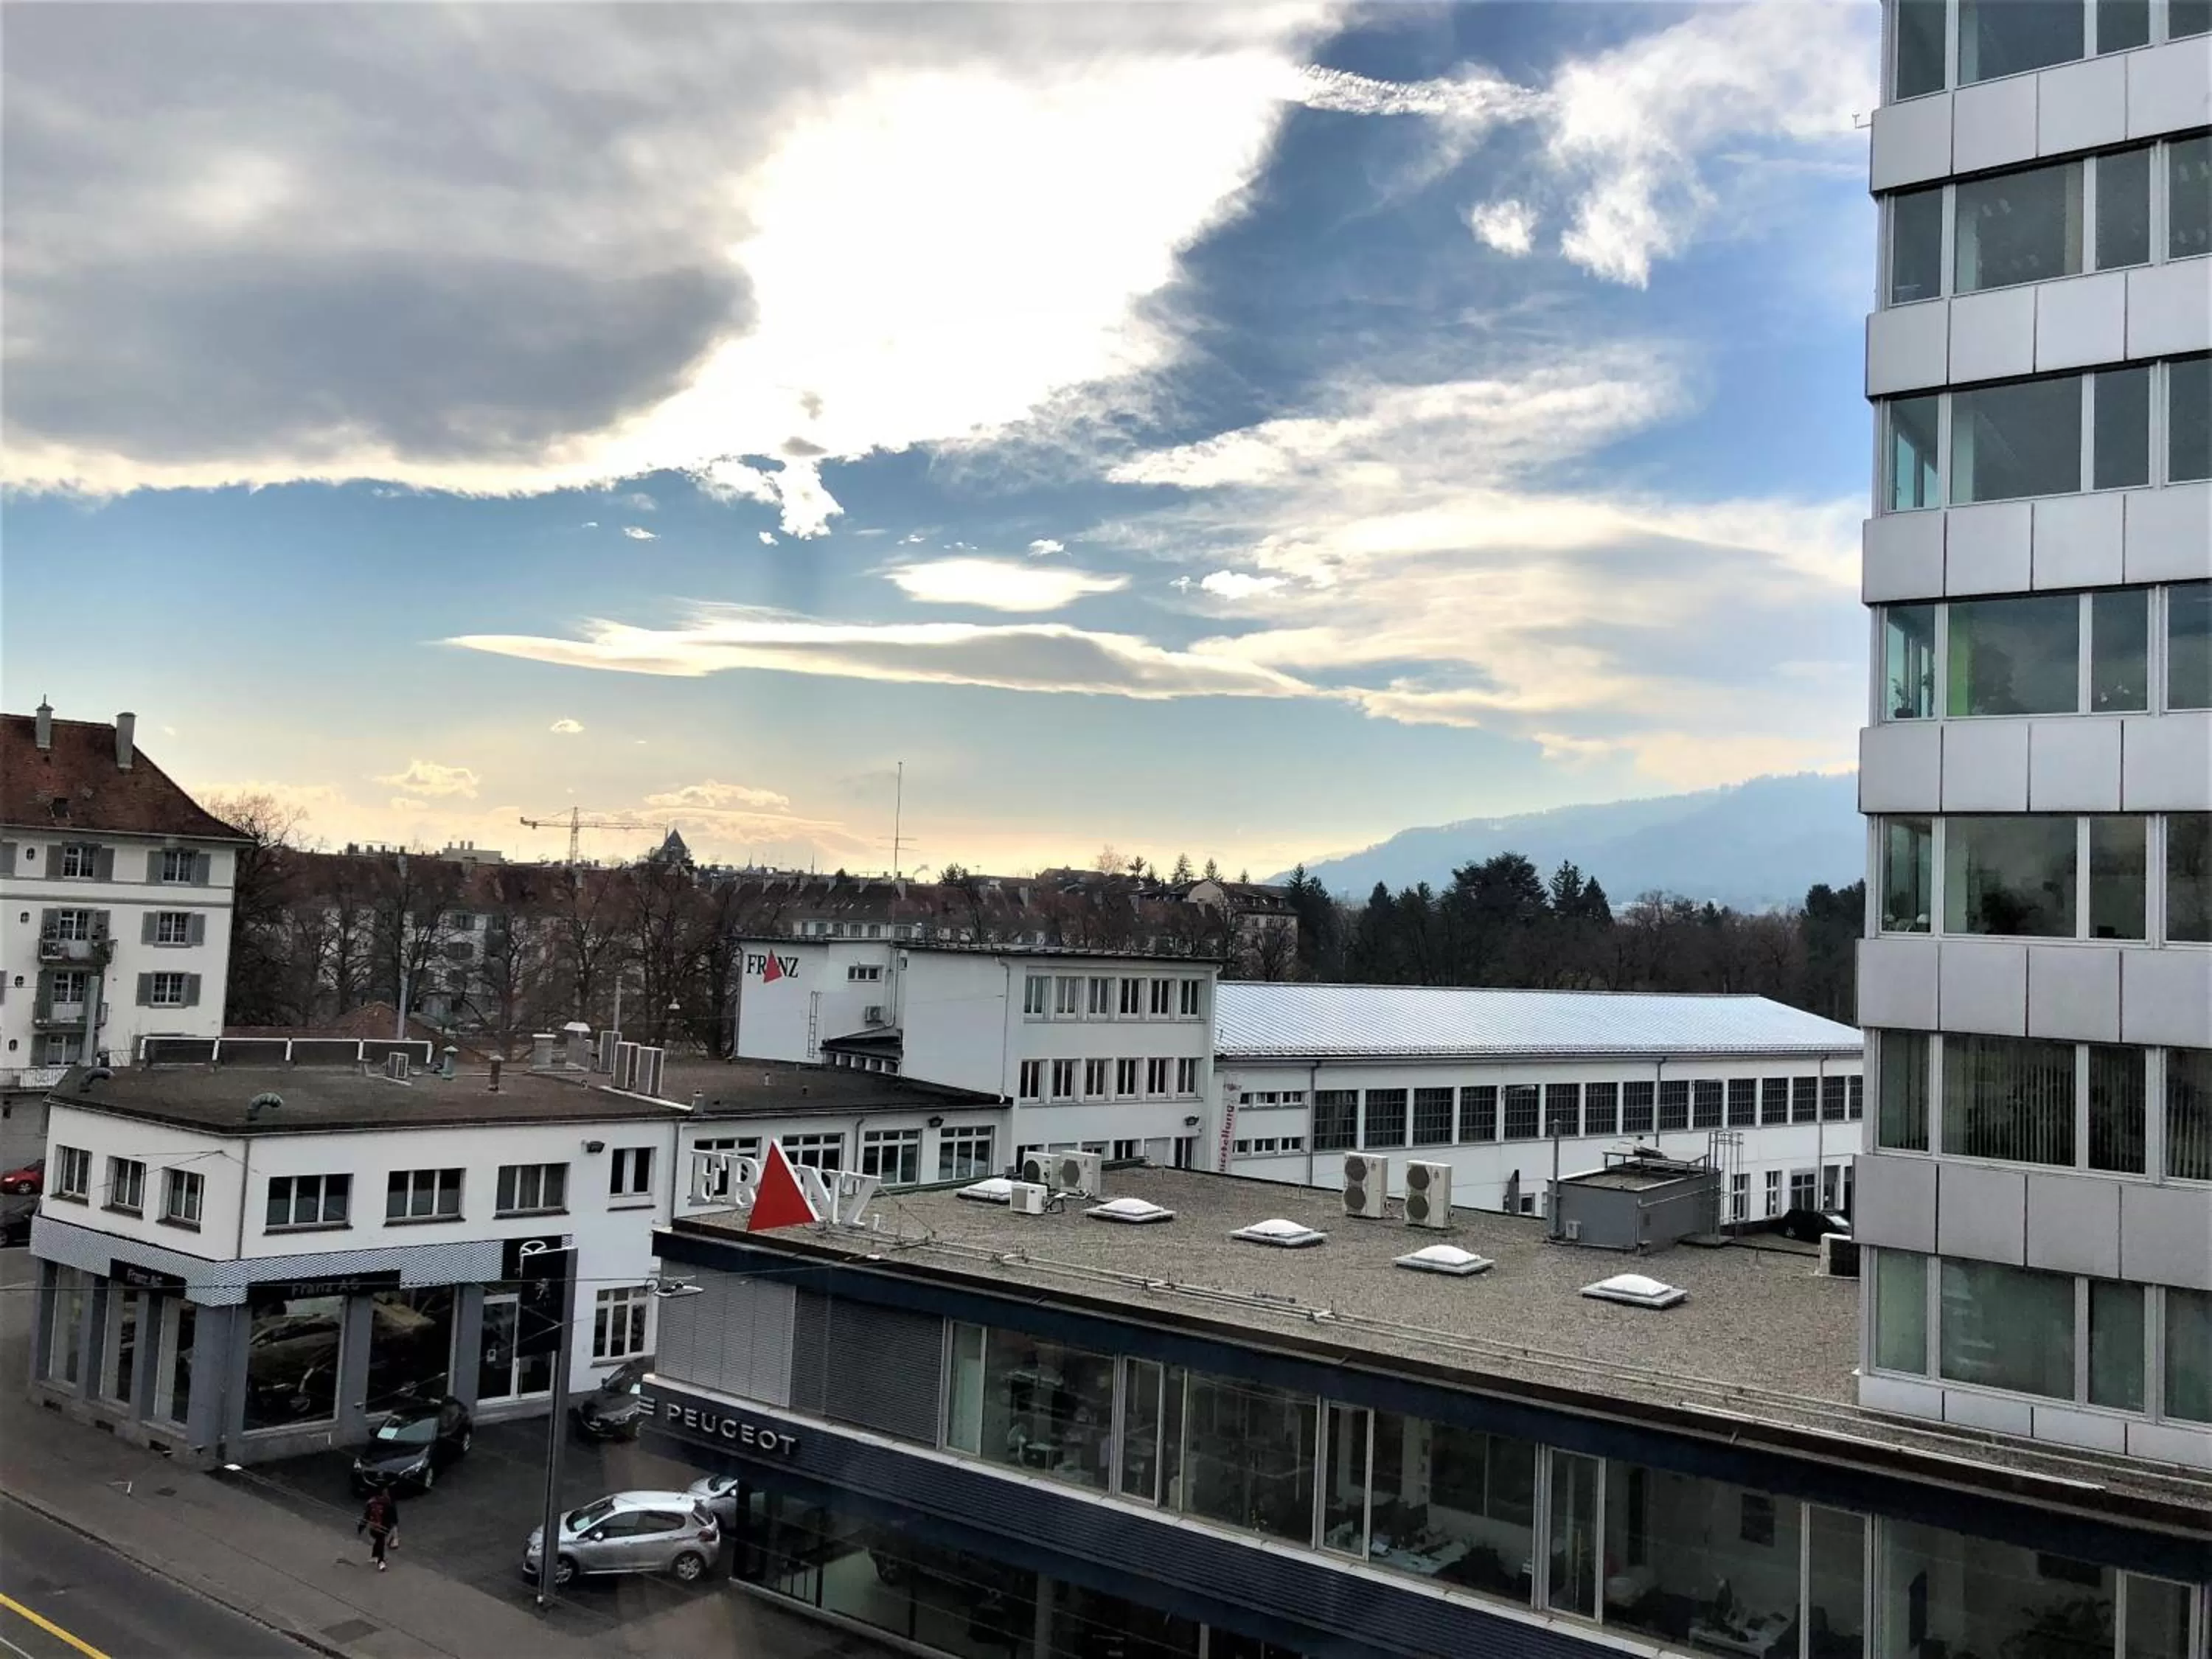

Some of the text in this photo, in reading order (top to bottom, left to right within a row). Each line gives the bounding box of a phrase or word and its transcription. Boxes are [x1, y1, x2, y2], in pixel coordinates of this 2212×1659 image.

[746, 947, 799, 983] FRANZ
[687, 1139, 882, 1232] FRANZ
[667, 1403, 796, 1455] PEUGEOT
